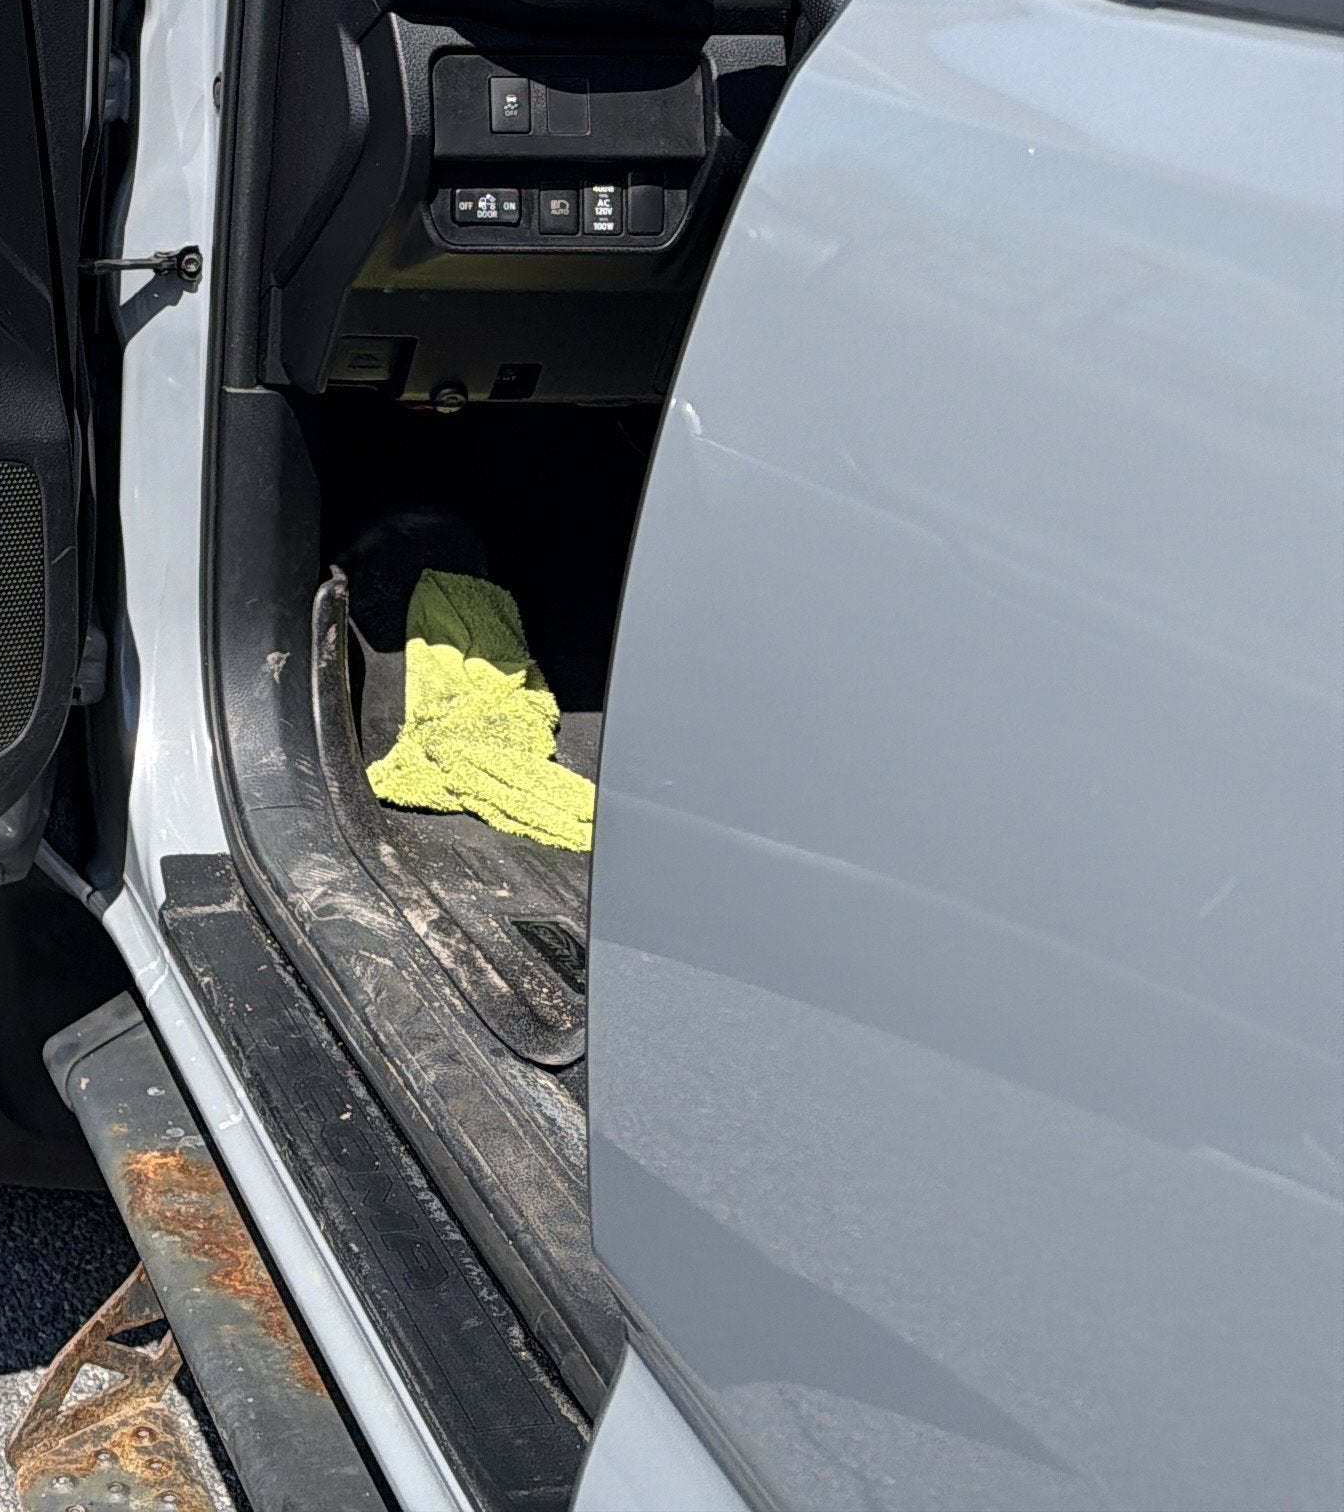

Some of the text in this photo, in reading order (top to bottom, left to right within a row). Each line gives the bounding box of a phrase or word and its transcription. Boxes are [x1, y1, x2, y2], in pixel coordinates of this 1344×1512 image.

[504, 109, 518, 117] OFF
[458, 202, 516, 211] OFF ON
[597, 199, 611, 207] AC
[476, 211, 498, 219] DOOR
[550, 208, 570, 216] AUTO
[594, 207, 613, 216] 120V
[592, 222, 615, 231] 100W
